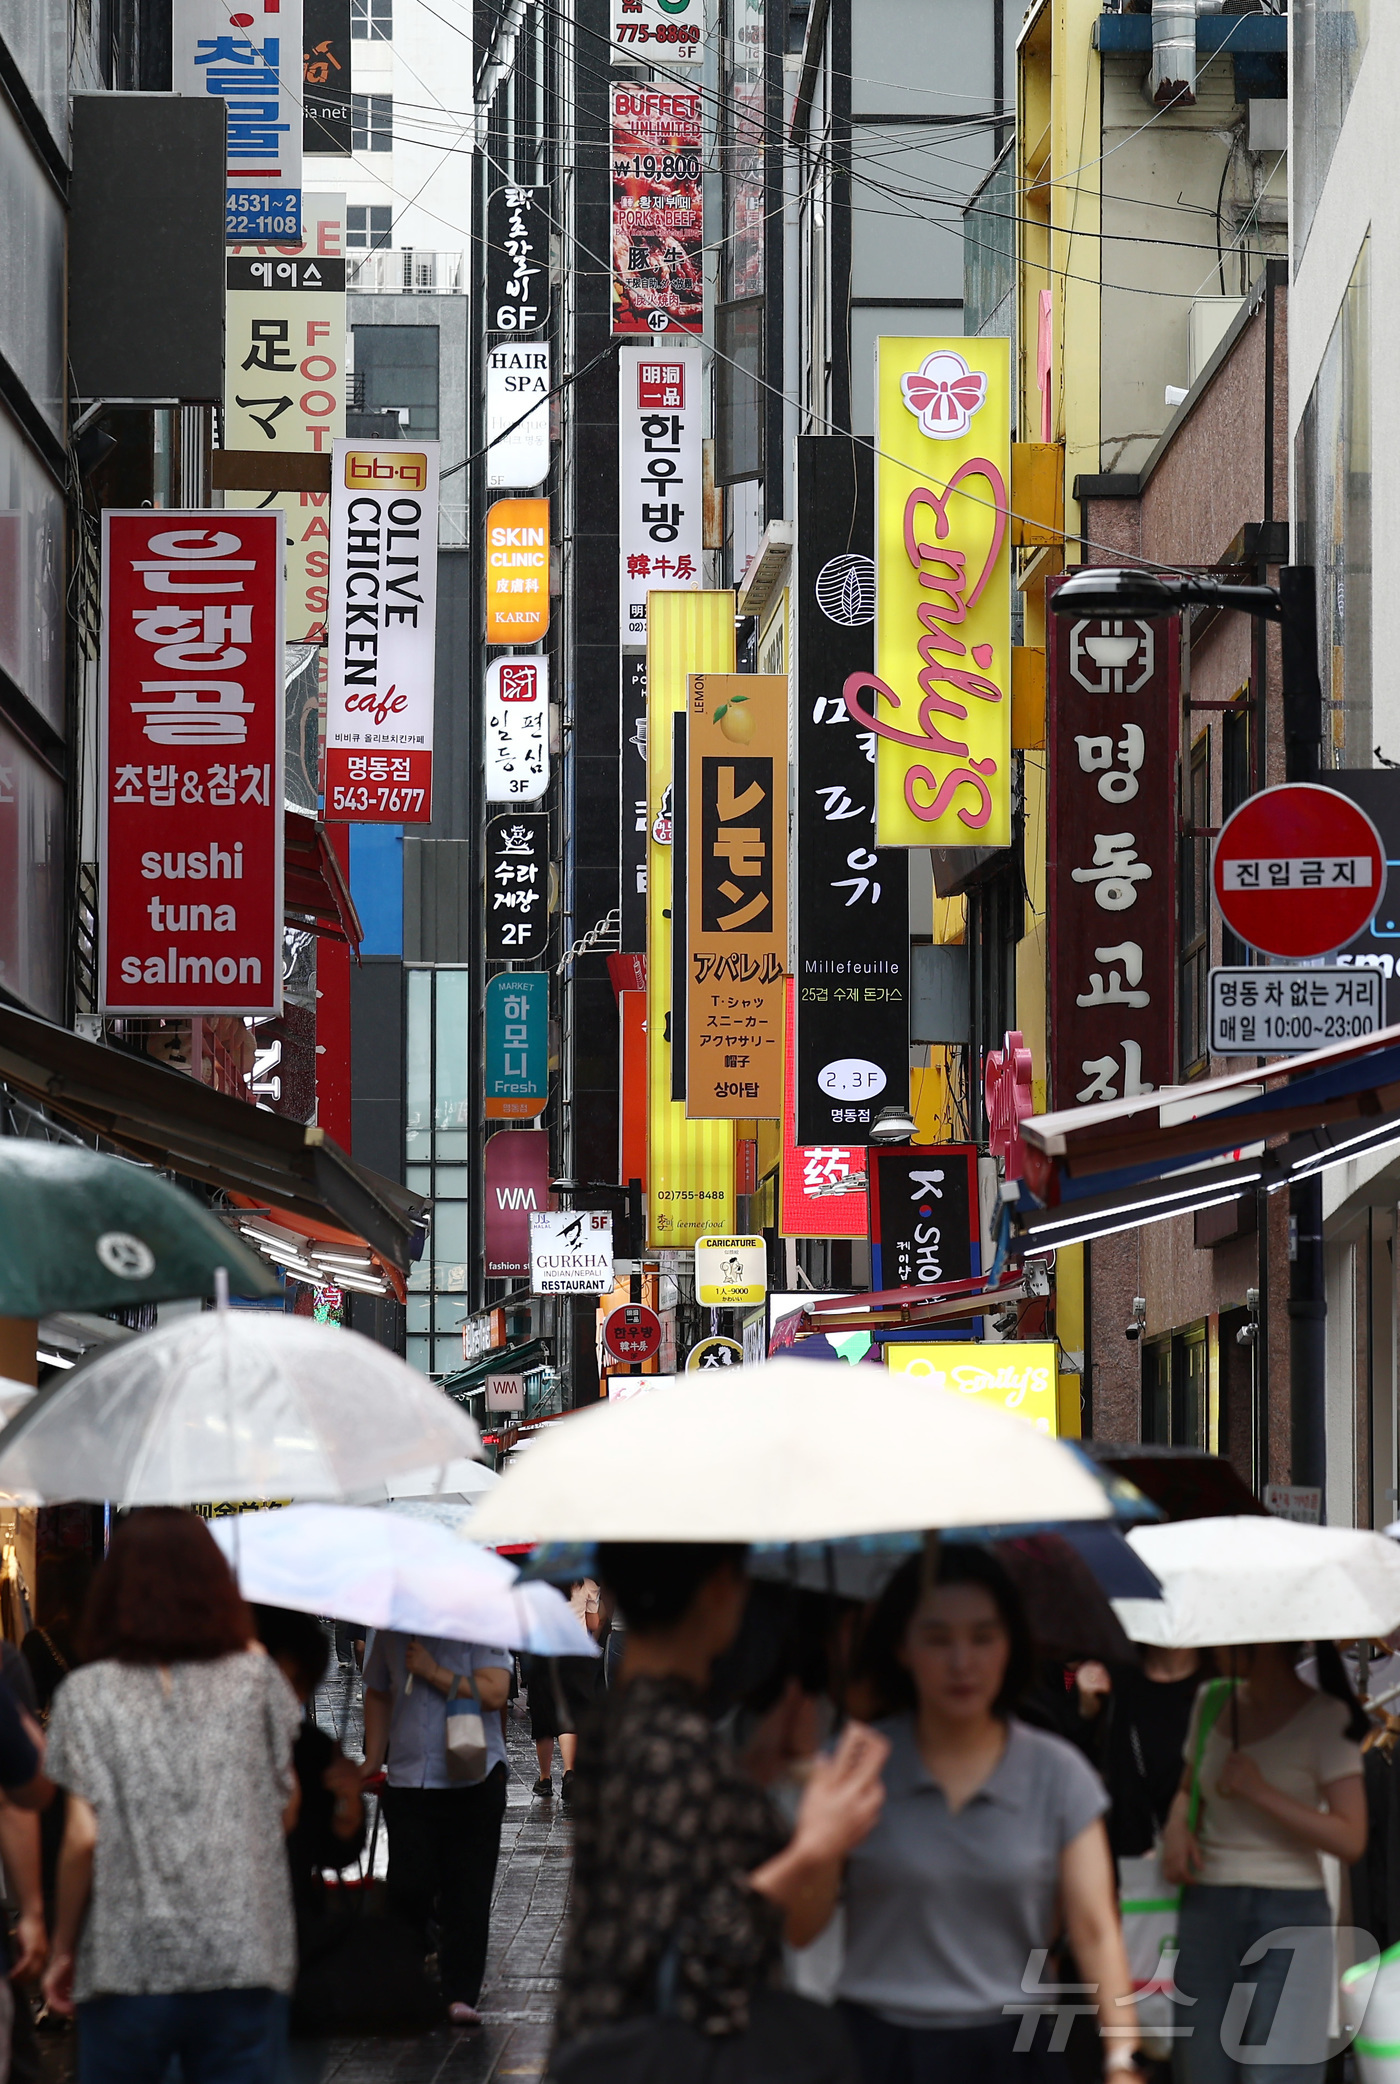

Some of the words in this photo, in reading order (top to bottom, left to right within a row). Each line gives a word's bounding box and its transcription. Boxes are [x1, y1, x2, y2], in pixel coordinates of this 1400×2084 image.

[616, 24, 700, 43] 775-8860
[678, 46, 697, 58] 5F
[615, 94, 700, 116] BUFFET
[631, 122, 700, 137] UNLIMITED
[619, 211, 651, 226] PORK
[665, 211, 696, 226] BEEF
[250, 262, 323, 287] 에이스
[497, 305, 538, 330] 6F
[649, 314, 666, 328] 4F
[491, 353, 547, 369] HAIR
[505, 376, 547, 392] SPA
[642, 366, 680, 384] 明洞
[300, 321, 336, 451] FOOT
[643, 387, 680, 406] 一品
[490, 476, 504, 485] 5F
[640, 414, 684, 543] 한우방
[491, 528, 544, 546] SKIN
[385, 498, 424, 628] OLIVE
[490, 553, 544, 567] CLINIC
[626, 554, 697, 580] 韓牛房
[345, 497, 382, 686] CHICKEN
[496, 578, 539, 593] 皮膚科
[495, 611, 540, 623] KARIN
[130, 529, 257, 745] 은행골
[693, 674, 704, 713] LEMON
[345, 684, 408, 725] cafe
[335, 733, 360, 744] 비비큐
[364, 733, 425, 745] 올리브치킨카페
[348, 757, 411, 781] 명동점
[113, 764, 271, 807] 초밥&참치
[509, 780, 529, 793] 3F
[333, 786, 425, 814] 543-7677
[713, 766, 770, 931] レモン
[141, 842, 243, 879] sushi
[494, 861, 538, 886] 수라
[1236, 859, 1357, 888] 진입금지
[147, 896, 236, 932] tuna
[1072, 723, 1154, 1106] 명동교자
[501, 923, 532, 945] 2F
[121, 947, 262, 984] salmon
[694, 952, 784, 984] アパレル
[804, 960, 900, 975] Millefeuille
[499, 983, 534, 992] MARKET
[833, 987, 859, 1002] 수제
[863, 987, 903, 1002] 돈가스
[1219, 980, 1258, 1007] 명동
[1265, 980, 1284, 1006] 차
[1290, 979, 1330, 1007] 없는
[1335, 979, 1374, 1007] 거리
[707, 1015, 769, 1028] スニーカー
[1219, 1015, 1257, 1042] 매일
[1264, 1014, 1374, 1040] 10:00~23:00
[504, 995, 530, 1078] 하모니
[724, 1055, 750, 1068] 帽子
[495, 1081, 537, 1093] Fresh
[713, 1082, 760, 1098] 상아탑
[830, 1108, 871, 1123] 명동점
[803, 1147, 851, 1197] 药
[658, 1191, 725, 1200] 02)755-8488
[591, 1216, 608, 1229] 5F
[706, 1239, 756, 1247] CARICATURE
[489, 1262, 520, 1270] fashion
[536, 1255, 608, 1268] GURKHA
[541, 1280, 605, 1290] RESTAURANT
[614, 1327, 653, 1339] 한우방
